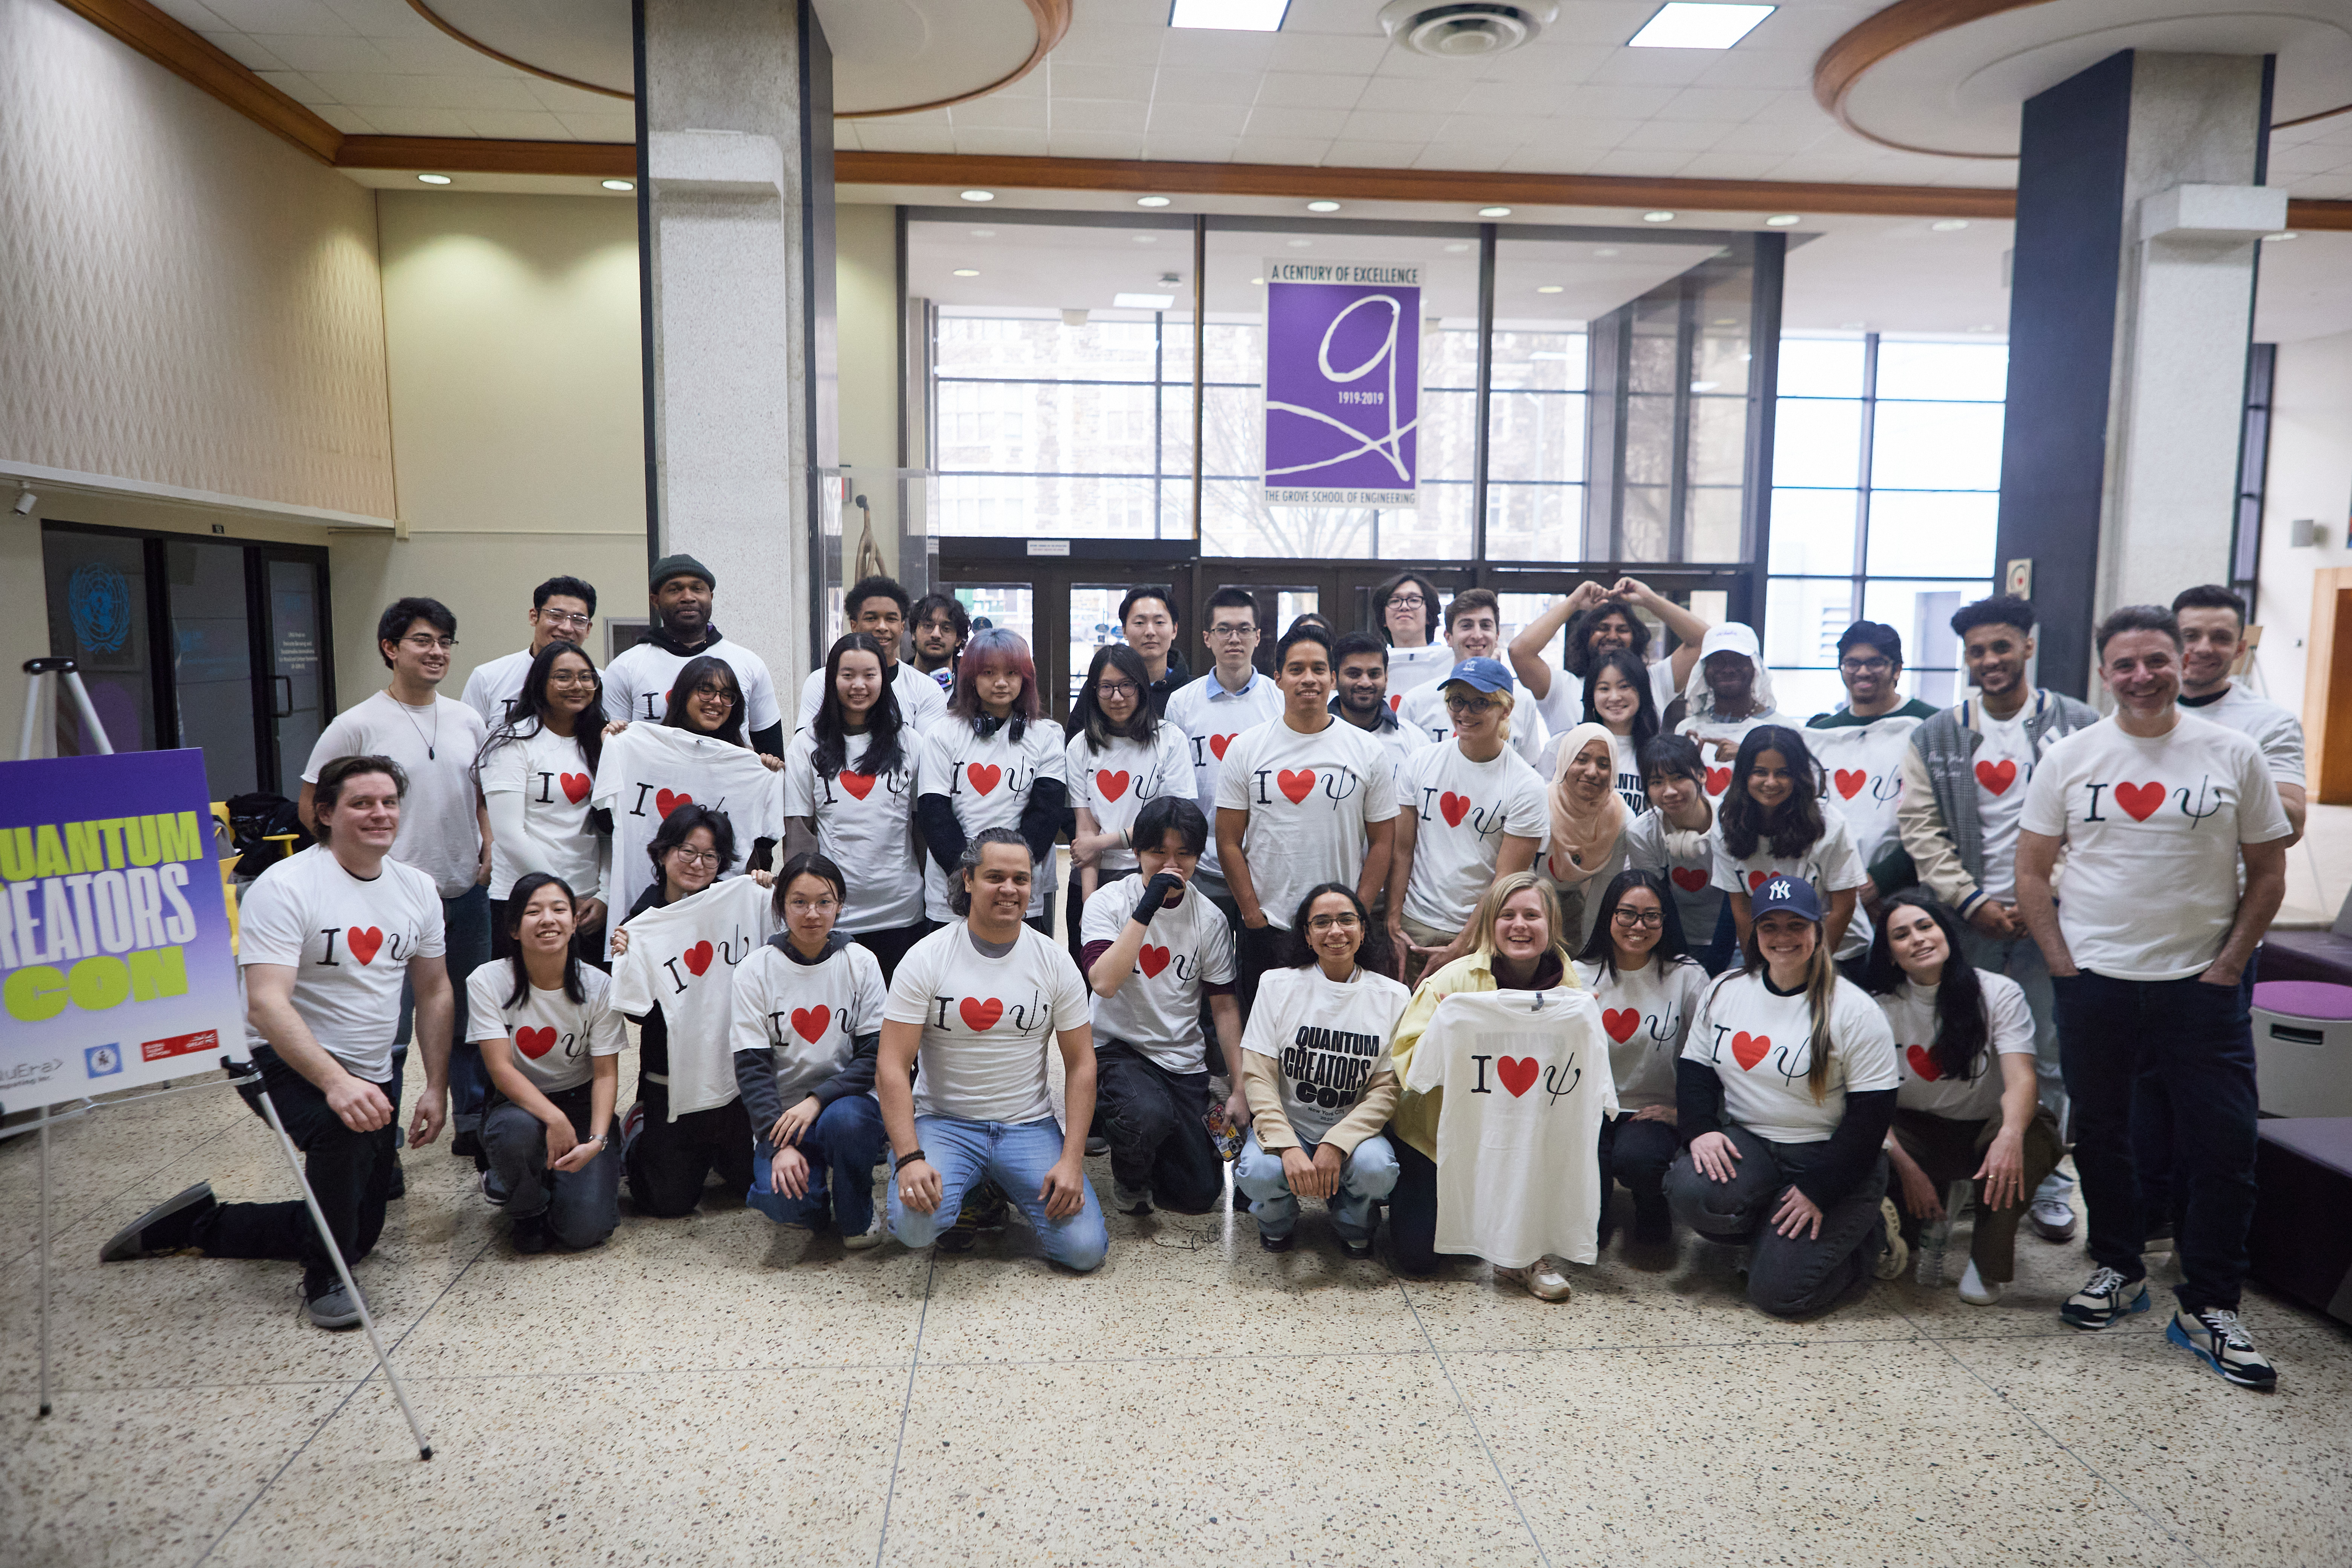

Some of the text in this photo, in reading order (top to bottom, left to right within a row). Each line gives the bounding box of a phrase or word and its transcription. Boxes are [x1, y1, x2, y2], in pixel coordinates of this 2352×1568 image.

[1271, 265, 1418, 284] A CENTURY OF EXCELLENCE
[1338, 391, 1384, 405] 1919-2019
[1265, 490, 1415, 504] THE GROVE SCHOOL OF ENGINEERING
[642, 692, 661, 720] I
[1191, 736, 1205, 767] I
[535, 772, 554, 803] I
[629, 782, 654, 817] I
[1255, 770, 1272, 804] I
[1421, 787, 1438, 821] I
[2084, 784, 2108, 822] I
[0, 811, 202, 882] UANTUM
[316, 928, 341, 966] I
[4, 945, 188, 1022] CON
[664, 957, 688, 994] I
[769, 1011, 789, 1046] I
[934, 996, 954, 1031] I
[1295, 1026, 1380, 1057] QUANTUM
[1711, 1024, 1731, 1064] I
[1283, 1047, 1371, 1090] CREATORS
[1471, 1055, 1492, 1094] I
[1295, 1082, 1358, 1109] CON
